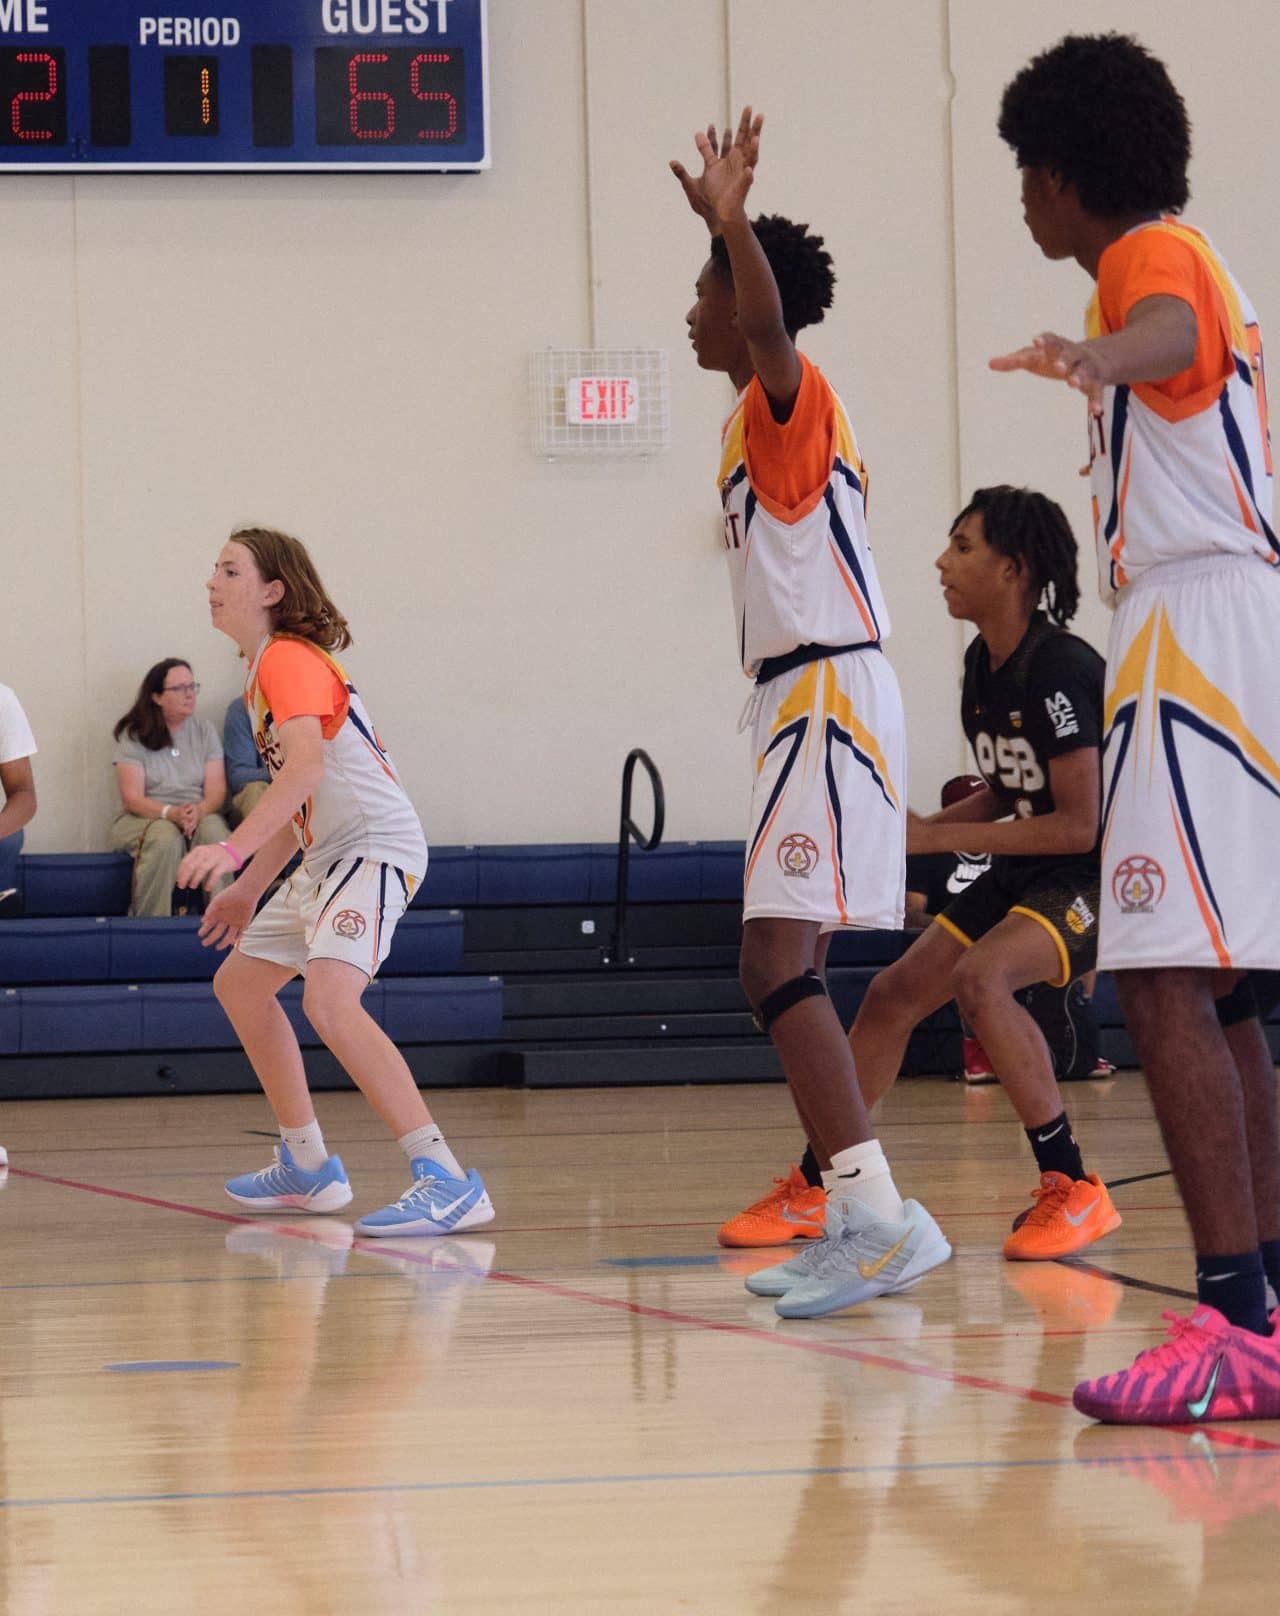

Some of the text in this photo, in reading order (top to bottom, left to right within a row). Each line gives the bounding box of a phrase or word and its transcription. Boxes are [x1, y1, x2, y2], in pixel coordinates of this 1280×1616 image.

[139, 16, 241, 46] PERIOD
[321, 0, 454, 34] GUEST
[11, 52, 57, 140] 2
[201, 67, 210, 124] 1
[348, 53, 457, 139] 65
[580, 379, 631, 420] EXIT
